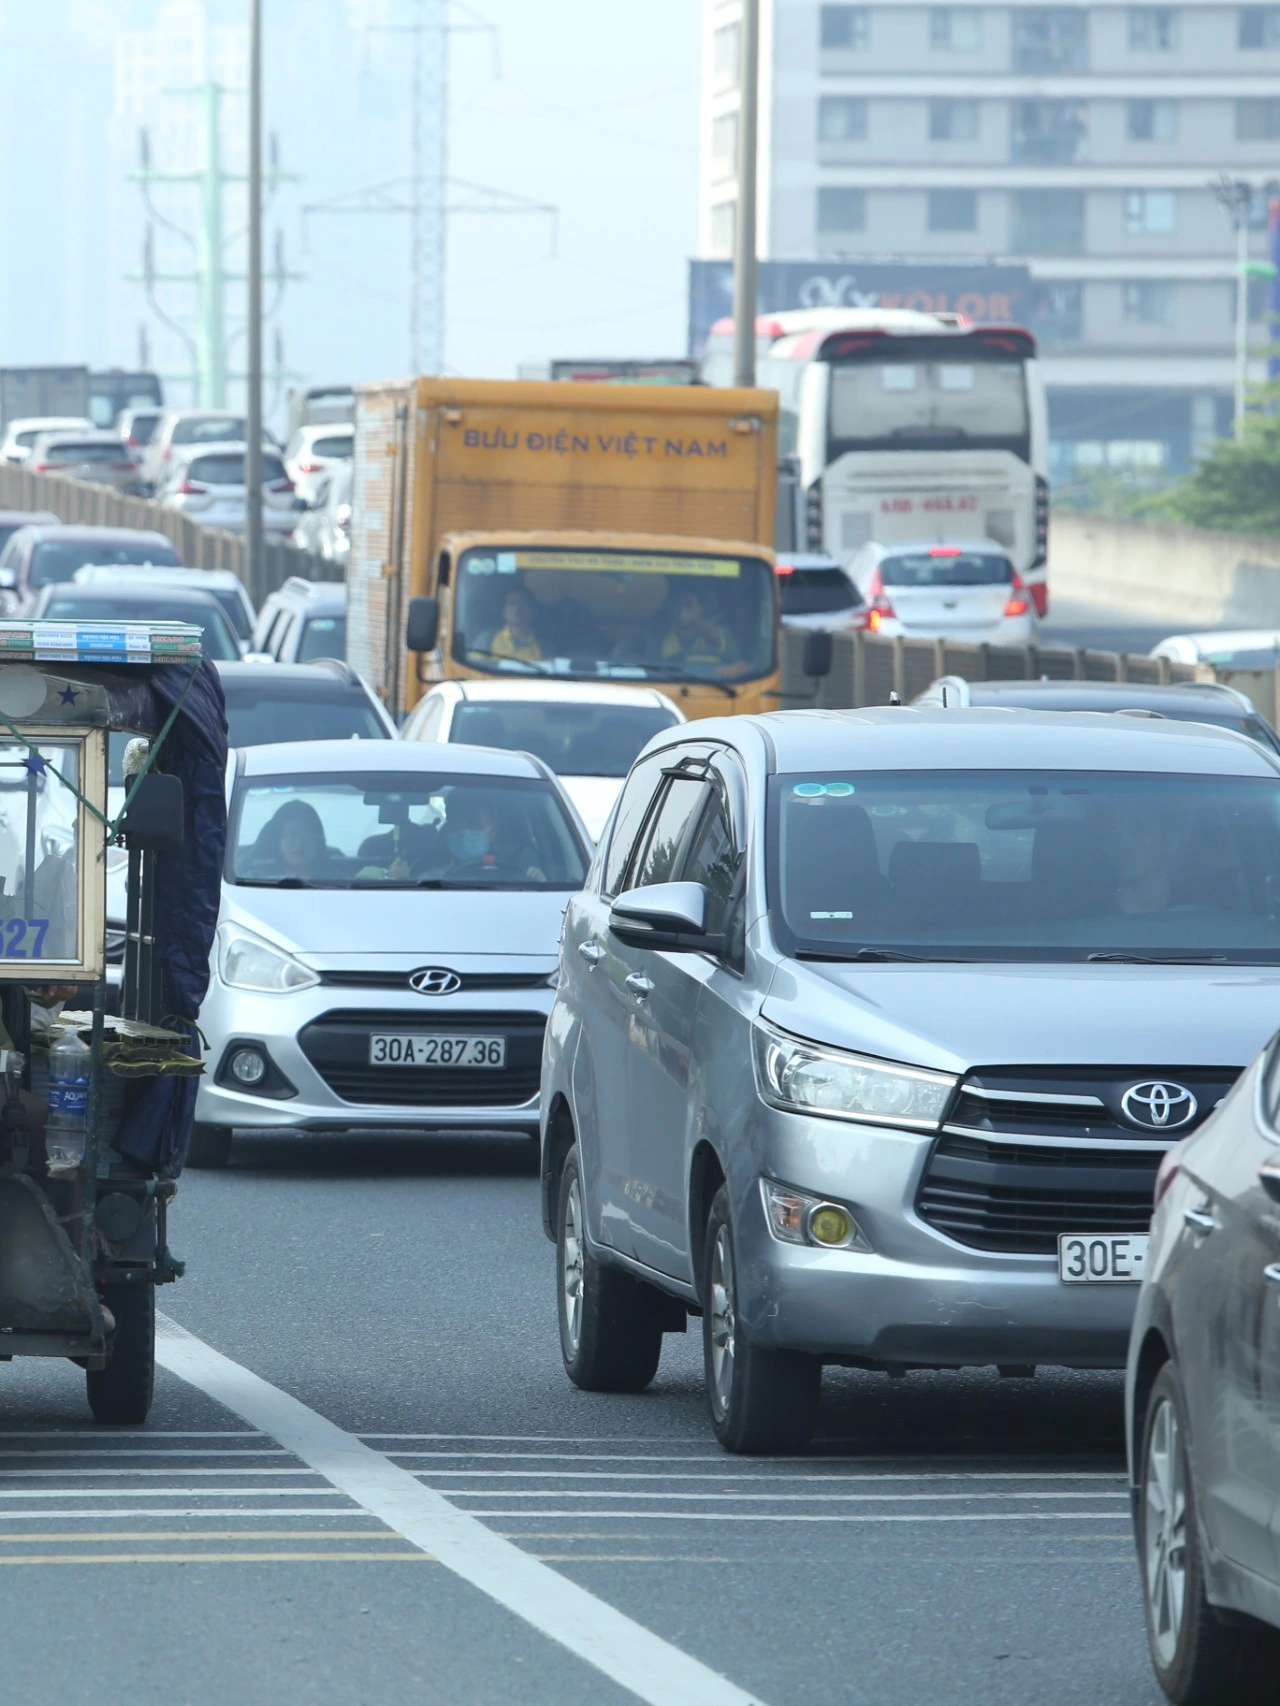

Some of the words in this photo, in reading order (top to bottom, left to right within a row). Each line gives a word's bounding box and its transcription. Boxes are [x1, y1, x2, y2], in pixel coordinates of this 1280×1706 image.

[463, 427, 518, 449] BƯU
[526, 429, 589, 457] ĐIỆN
[596, 430, 658, 459] VIỆT
[664, 436, 728, 458] NAM
[374, 1038, 501, 1065] 30A-287.36
[1067, 1240, 1144, 1277] 30E-
